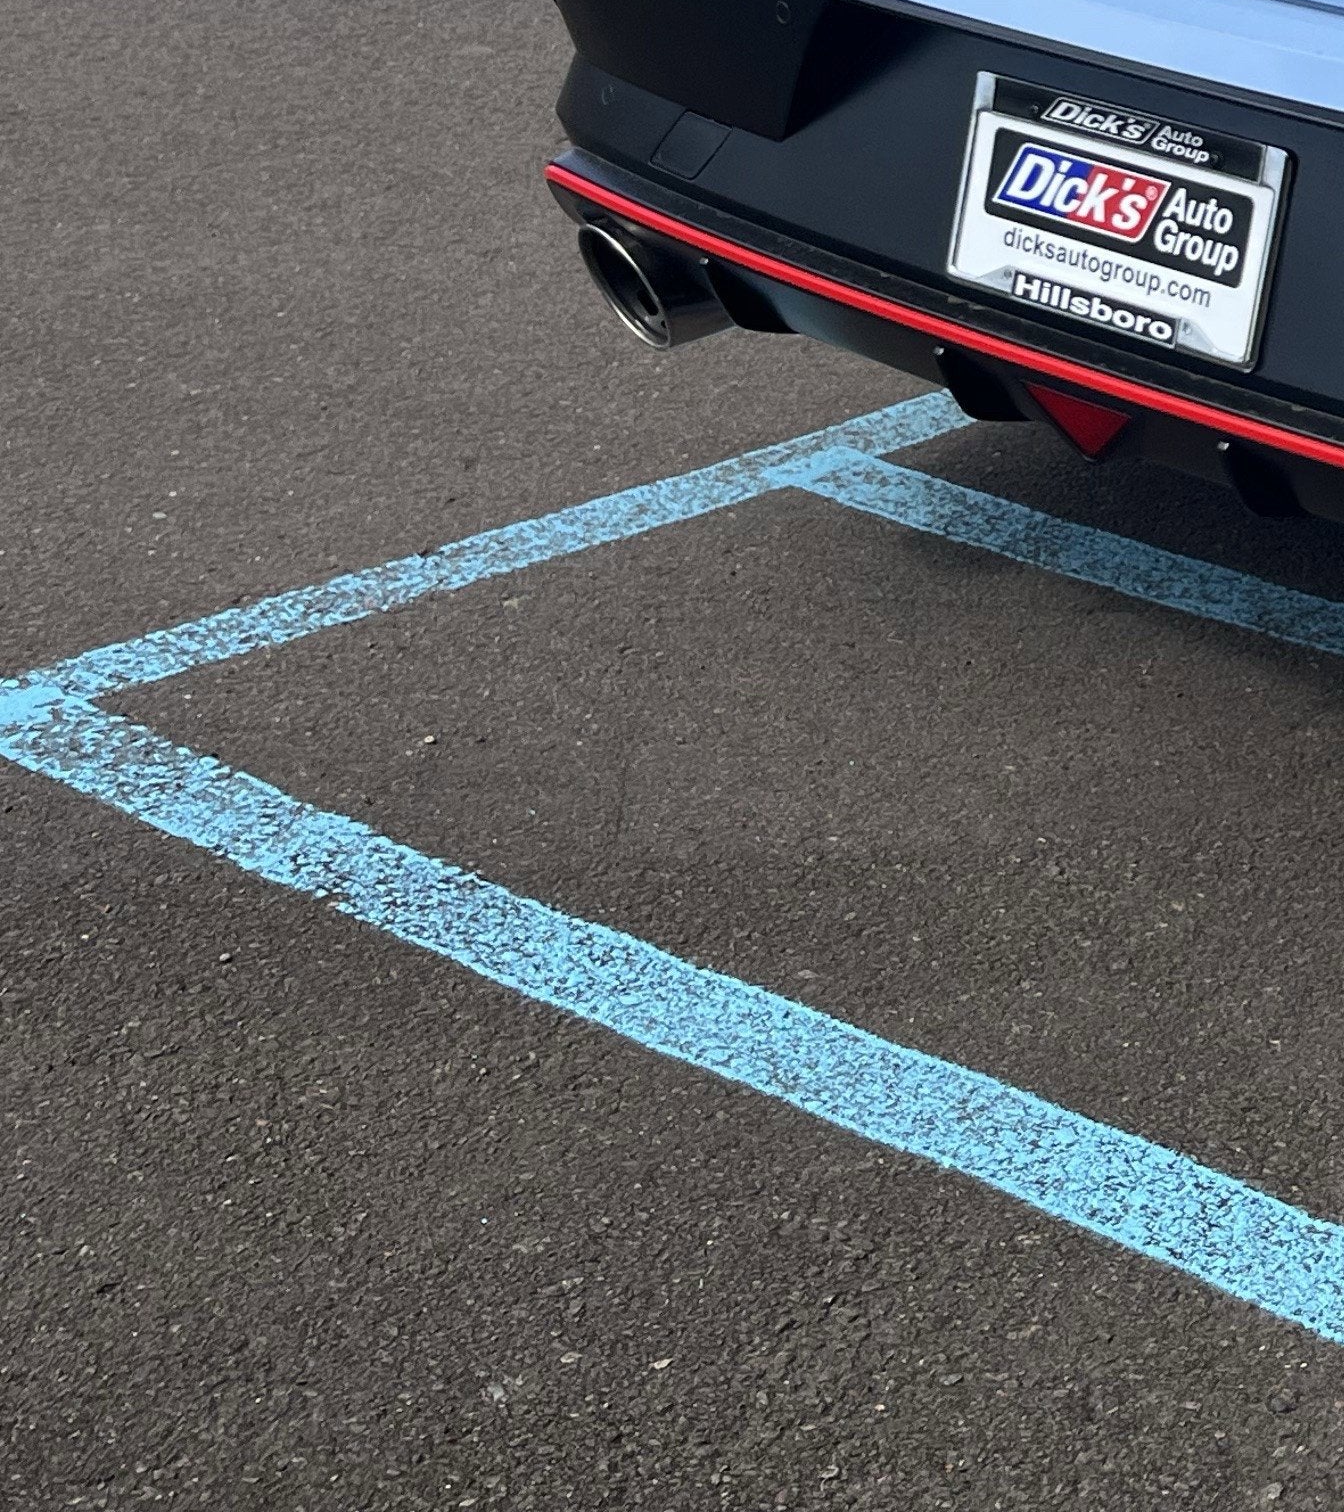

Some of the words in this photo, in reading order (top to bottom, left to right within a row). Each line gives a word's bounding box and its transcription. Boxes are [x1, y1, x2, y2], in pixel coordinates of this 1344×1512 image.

[1050, 101, 1146, 139] Dick's
[1157, 125, 1204, 148] Auto
[1151, 138, 1210, 164] Group
[1006, 153, 1148, 232] Dick's
[1162, 188, 1234, 234] Auto
[1003, 227, 1213, 308] dicksautogroup.com
[1153, 219, 1240, 276] Group
[1014, 273, 1173, 340] Hillsboro
